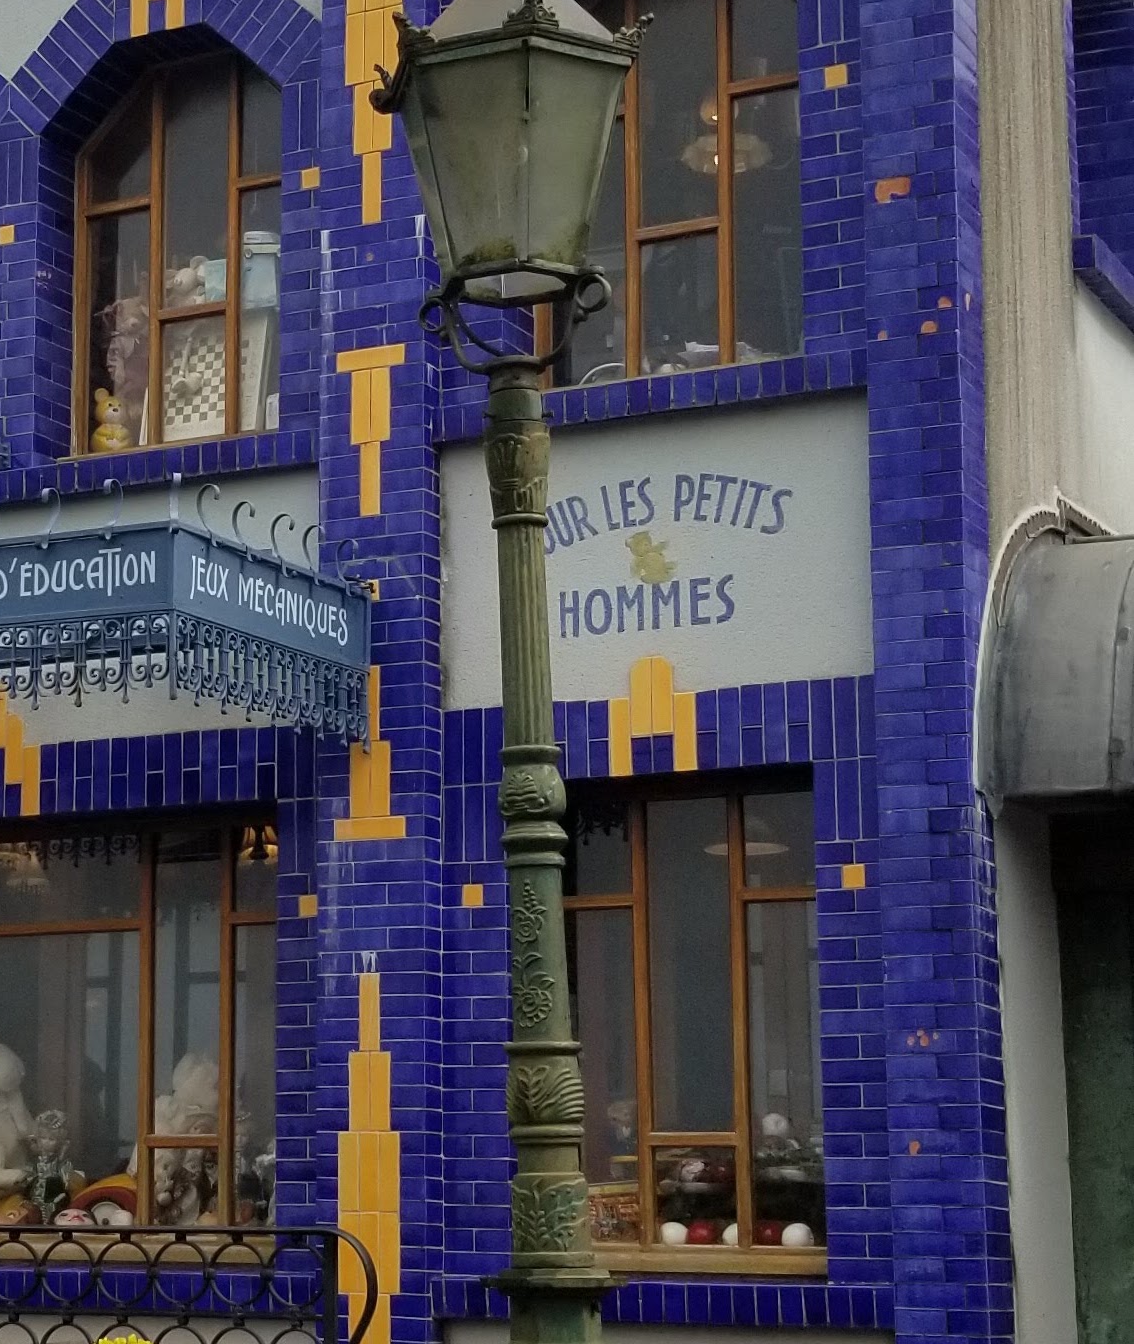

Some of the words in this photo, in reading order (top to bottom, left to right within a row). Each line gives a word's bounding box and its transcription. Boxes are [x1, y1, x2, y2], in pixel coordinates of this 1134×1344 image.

[600, 476, 655, 531] LES
[673, 473, 793, 535] PETITS
[189, 554, 230, 602] JEUX
[237, 573, 349, 647] MÉCANIQUES
[559, 574, 736, 639] HOMMES
